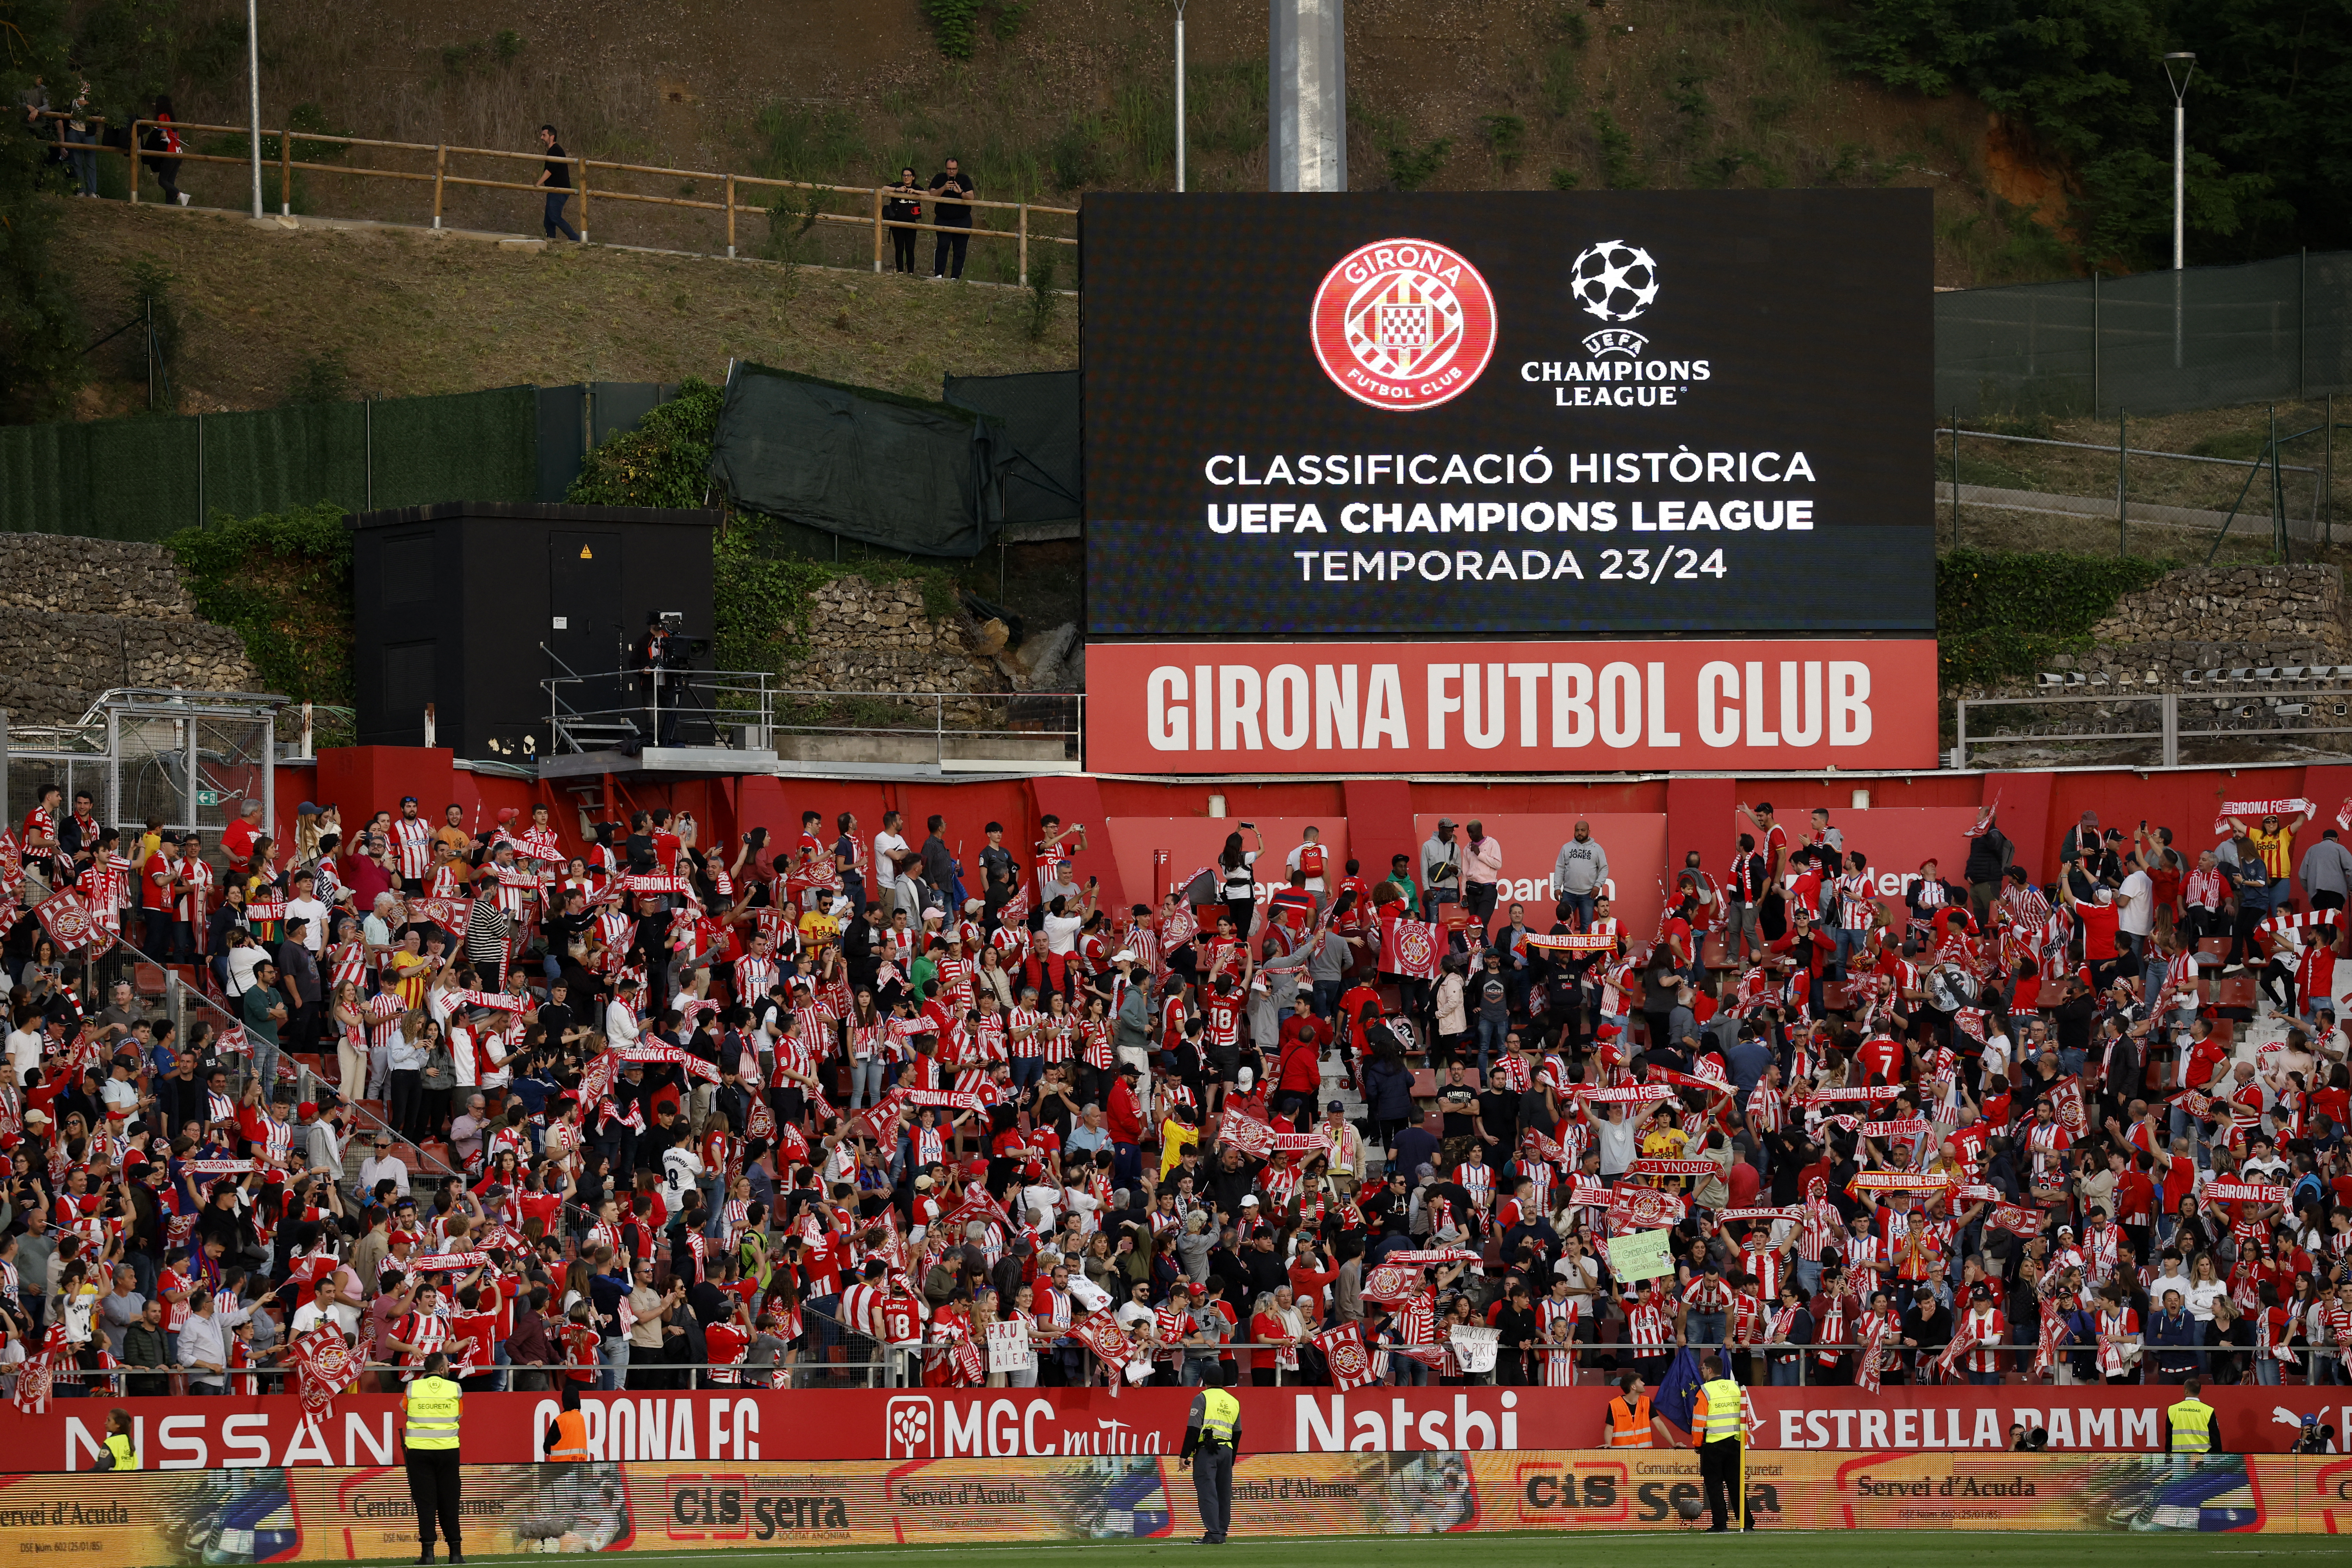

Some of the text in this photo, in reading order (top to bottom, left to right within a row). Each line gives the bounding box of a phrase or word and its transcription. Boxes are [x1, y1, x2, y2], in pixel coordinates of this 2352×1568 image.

[1344, 245, 1461, 289] GIRONA
[1587, 334, 1640, 357] UEFA
[1521, 359, 1711, 383] CHAMPIONS
[1347, 364, 1466, 400] FUTBOL CLUB
[1555, 386, 1679, 407] LEAGUE
[1205, 444, 1815, 486] CLASSIFICACIÓ HISTÒRICA
[1207, 499, 1814, 534] UEFA CHAMPIONS LEAGUE
[1292, 547, 1727, 584] TEMPORADA 23/24
[1146, 660, 1873, 751] GIRONA FUTBOL CLUB
[2232, 799, 2282, 814] GIRONA FC
[407, 838, 428, 846] Gosbi
[505, 837, 548, 859] GIRONA FC
[1161, 855, 1167, 864] F
[316, 868, 335, 900] ORGULL
[505, 874, 537, 887] GIRONA
[634, 877, 686, 891] GIRONA FC
[808, 875, 821, 884] FUTBOL
[38, 900, 54, 911] HYLO
[272, 904, 283, 919] FC
[72, 906, 89, 929] GIRONA
[1398, 923, 1428, 940] GIRONA
[1526, 932, 1612, 947] GIRONA FUTBOL CLUB
[1402, 960, 1419, 970] FUTBOL
[467, 988, 513, 1010] GIRONA FC
[902, 1019, 928, 1034] GIRONA FC
[1210, 1007, 1232, 1029] 18
[625, 1049, 679, 1061] GIRONA FC
[693, 1059, 702, 1073] FC
[1880, 1055, 1892, 1078] 7
[911, 1091, 963, 1107] GIRONA FC
[1597, 1085, 1652, 1102] GIRONA FC
[1829, 1086, 1883, 1100] GIRONA FC
[2050, 1086, 2063, 1096] HYLO
[867, 1108, 879, 1119] HYLO
[1242, 1116, 1264, 1131] GIRONA
[1962, 1135, 1976, 1144] AGUS
[921, 1145, 941, 1154] Gosbi
[1963, 1140, 1982, 1162] 10
[201, 1161, 235, 1169] GIRONA
[1641, 1159, 1713, 1174] GIRONA FC
[668, 1168, 679, 1191] 8
[1465, 1182, 1487, 1191] Gosbi
[1857, 1173, 1947, 1187] GIRONA FUTBOL CLUB
[1635, 1189, 1662, 1201] GIRONA
[2217, 1183, 2276, 1200] GIRONA FC
[1724, 1208, 1799, 1217] GIRONA FC
[885, 1227, 898, 1253] GIRONA
[981, 1243, 1001, 1253] Gosbi
[1610, 1233, 1664, 1250] MIGUEL ES
[432, 1254, 465, 1268] GIRONA
[1410, 1250, 1460, 1261] GIRONA FC
[1628, 1259, 1640, 1268] DAS
[1410, 1306, 1430, 1314] Gosb
[886, 1314, 909, 1338] 18
[1056, 1314, 1070, 1324] Gosbi
[988, 1322, 1017, 1340] PORTU
[1322, 1327, 1338, 1336] HYLO
[1094, 1337, 1104, 1353] FUTBOL
[1472, 1342, 1497, 1359] PORTU
[566, 1345, 577, 1365] 6
[1352, 1342, 1367, 1370] GIRONA
[37, 1366, 49, 1397] GIRONA
[318, 1369, 331, 1379] CLUB
[534, 1397, 760, 1461] GRONA FC
[944, 1398, 1056, 1457] MGC
[1295, 1390, 1518, 1452] Natsbi
[1778, 1408, 2002, 1449] ESTRELLA
[65, 1412, 393, 1472] NISSAN
[1527, 1473, 1617, 1508] cis
[1856, 1475, 2036, 1496] Servei d'Acuda
[0, 1500, 129, 1526] ervei d'Acuda
[674, 1488, 742, 1525] cis
[755, 1496, 849, 1541] serra
